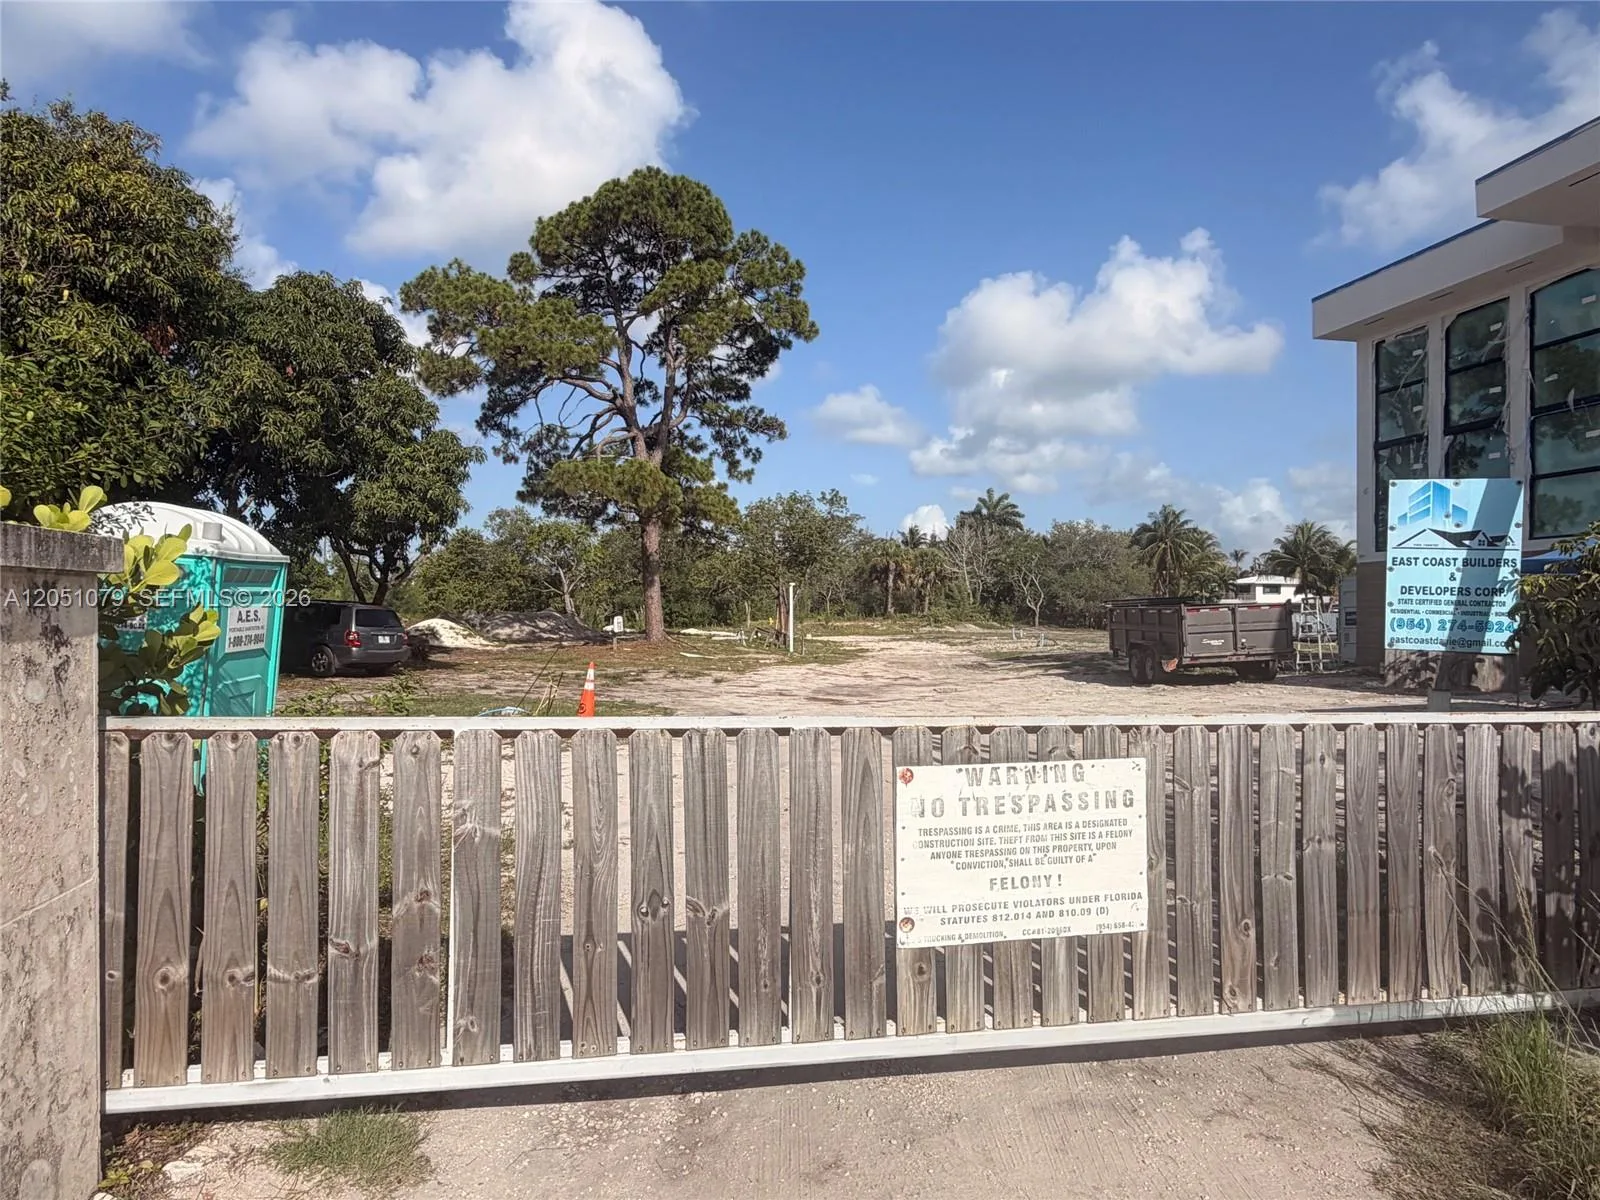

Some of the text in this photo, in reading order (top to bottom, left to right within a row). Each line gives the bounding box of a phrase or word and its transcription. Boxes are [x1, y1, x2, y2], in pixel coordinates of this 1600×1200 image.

[1391, 557, 1517, 568] EAST COAST BUILDERS
[1449, 572, 1457, 581] &
[1400, 586, 1471, 596] DEVELOPERS
[236, 609, 261, 624] A.E.S.
[1389, 617, 1431, 633] (954)
[964, 763, 1085, 787] WARNING
[910, 789, 1134, 818] NO TRESPASSING
[918, 826, 973, 837] TRESPASSING
[974, 825, 983, 835] IS
[984, 825, 991, 834] A
[1023, 822, 1041, 832] THIS
[1043, 821, 1063, 831] AREA
[1065, 820, 1073, 830] IS
[1074, 820, 1081, 829] A
[1082, 818, 1128, 829] DESIGNATED
[912, 838, 975, 849] CONSTRUCTION
[999, 835, 1023, 846] THEFT
[1025, 834, 1048, 844] FROM
[1050, 832, 1068, 843] THIS
[1069, 831, 1087, 841] SITE
[1088, 831, 1097, 840] IS
[1098, 830, 1104, 839] A
[1105, 829, 1133, 839] FELONY
[930, 850, 962, 861] ANYONE
[964, 847, 1017, 859] TRESPASSING
[1019, 846, 1030, 855] ON
[1032, 844, 1050, 854] THIS
[1095, 841, 1117, 851] UPON
[1008, 857, 1033, 868] SHALL
[1035, 856, 1046, 866] BE
[1047, 855, 1074, 865] GUILTY
[1075, 854, 1086, 864] OF
[989, 873, 1063, 892] FELONY !
[923, 905, 948, 915] WILL
[951, 901, 1010, 913] PROSECUTE
[1012, 897, 1066, 909] VIOLATORS
[1068, 894, 1101, 905] UNDER
[1104, 891, 1143, 903] FLORIDA
[939, 906, 1110, 926] STATUTES 812.014 AND 810.09 (D)
